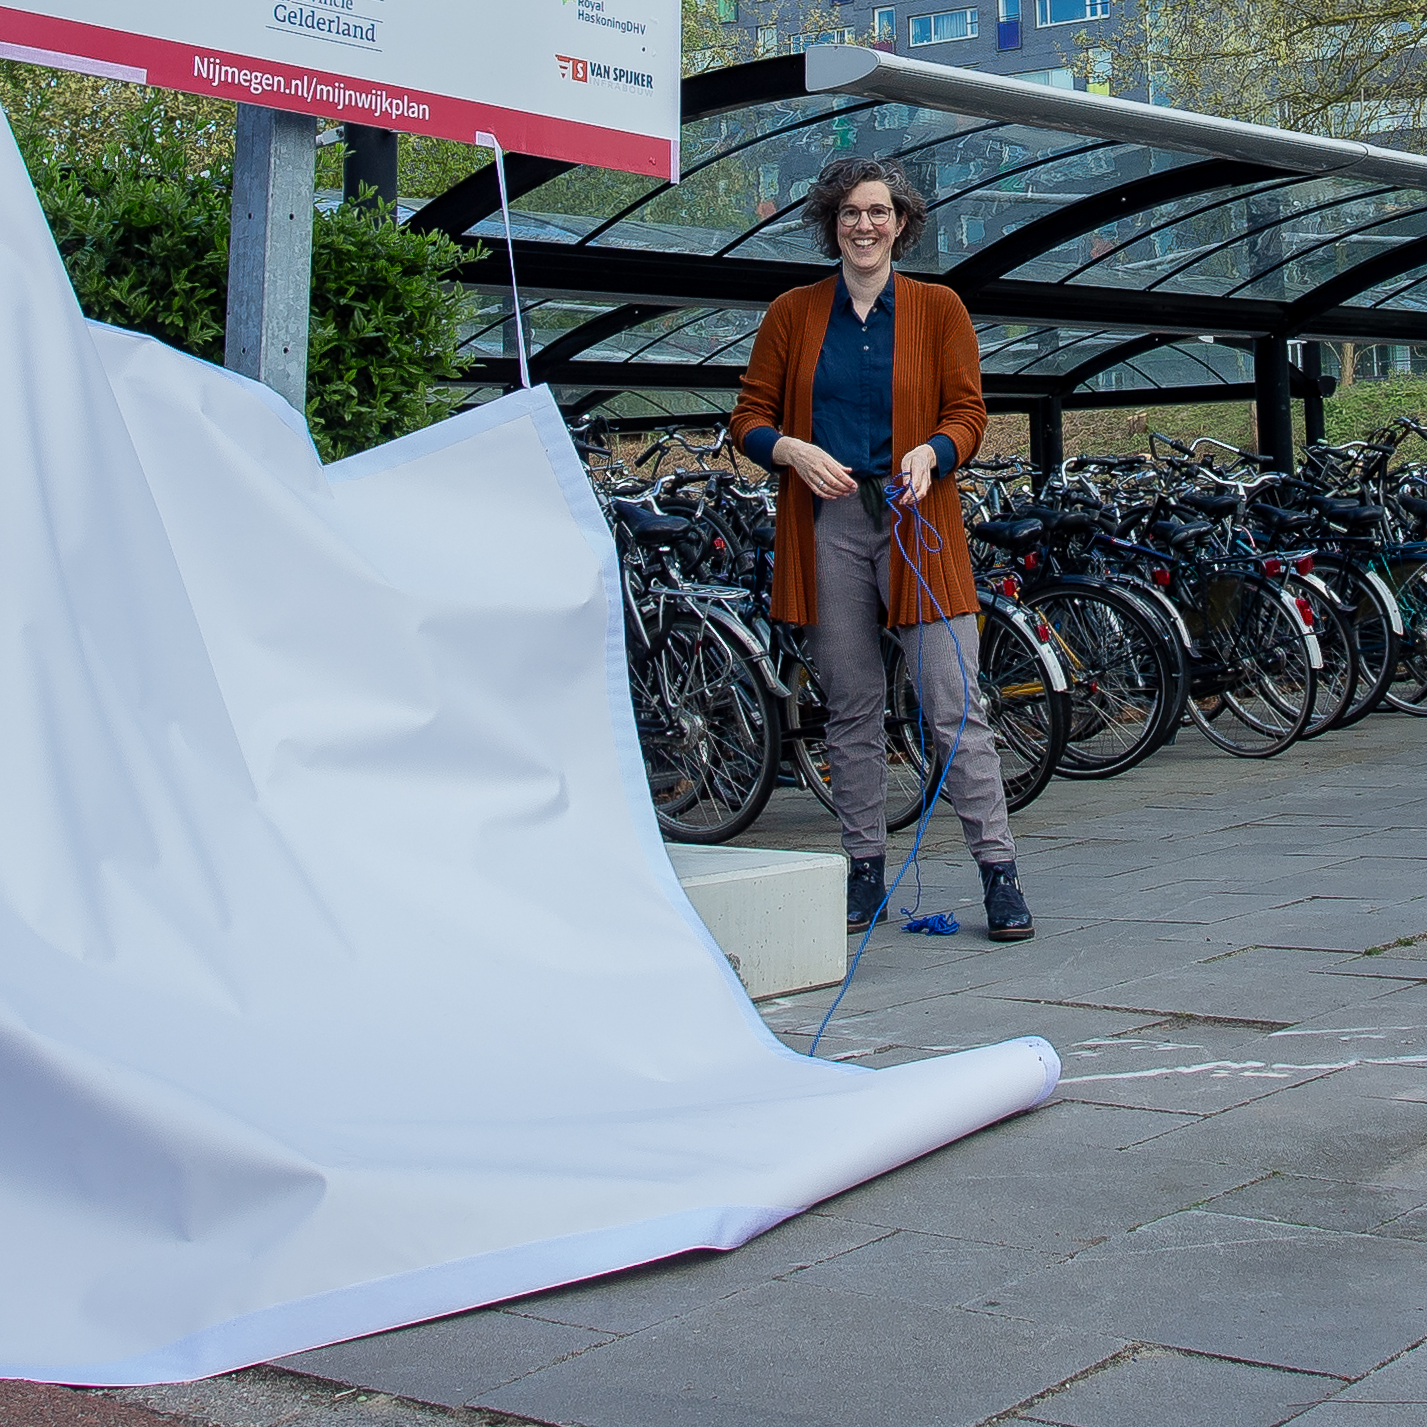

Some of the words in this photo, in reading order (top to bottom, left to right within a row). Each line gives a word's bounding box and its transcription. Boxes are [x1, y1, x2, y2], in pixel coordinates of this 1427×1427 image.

[274, 3, 377, 43] Gelderland
[577, 8, 646, 36] HaskoningDHV
[192, 54, 431, 121] Nijmegen.nl/mijnwijkplan
[589, 61, 611, 80] VAN
[612, 67, 654, 90] SPIJKER
[589, 77, 654, 97] INFRABOUW
